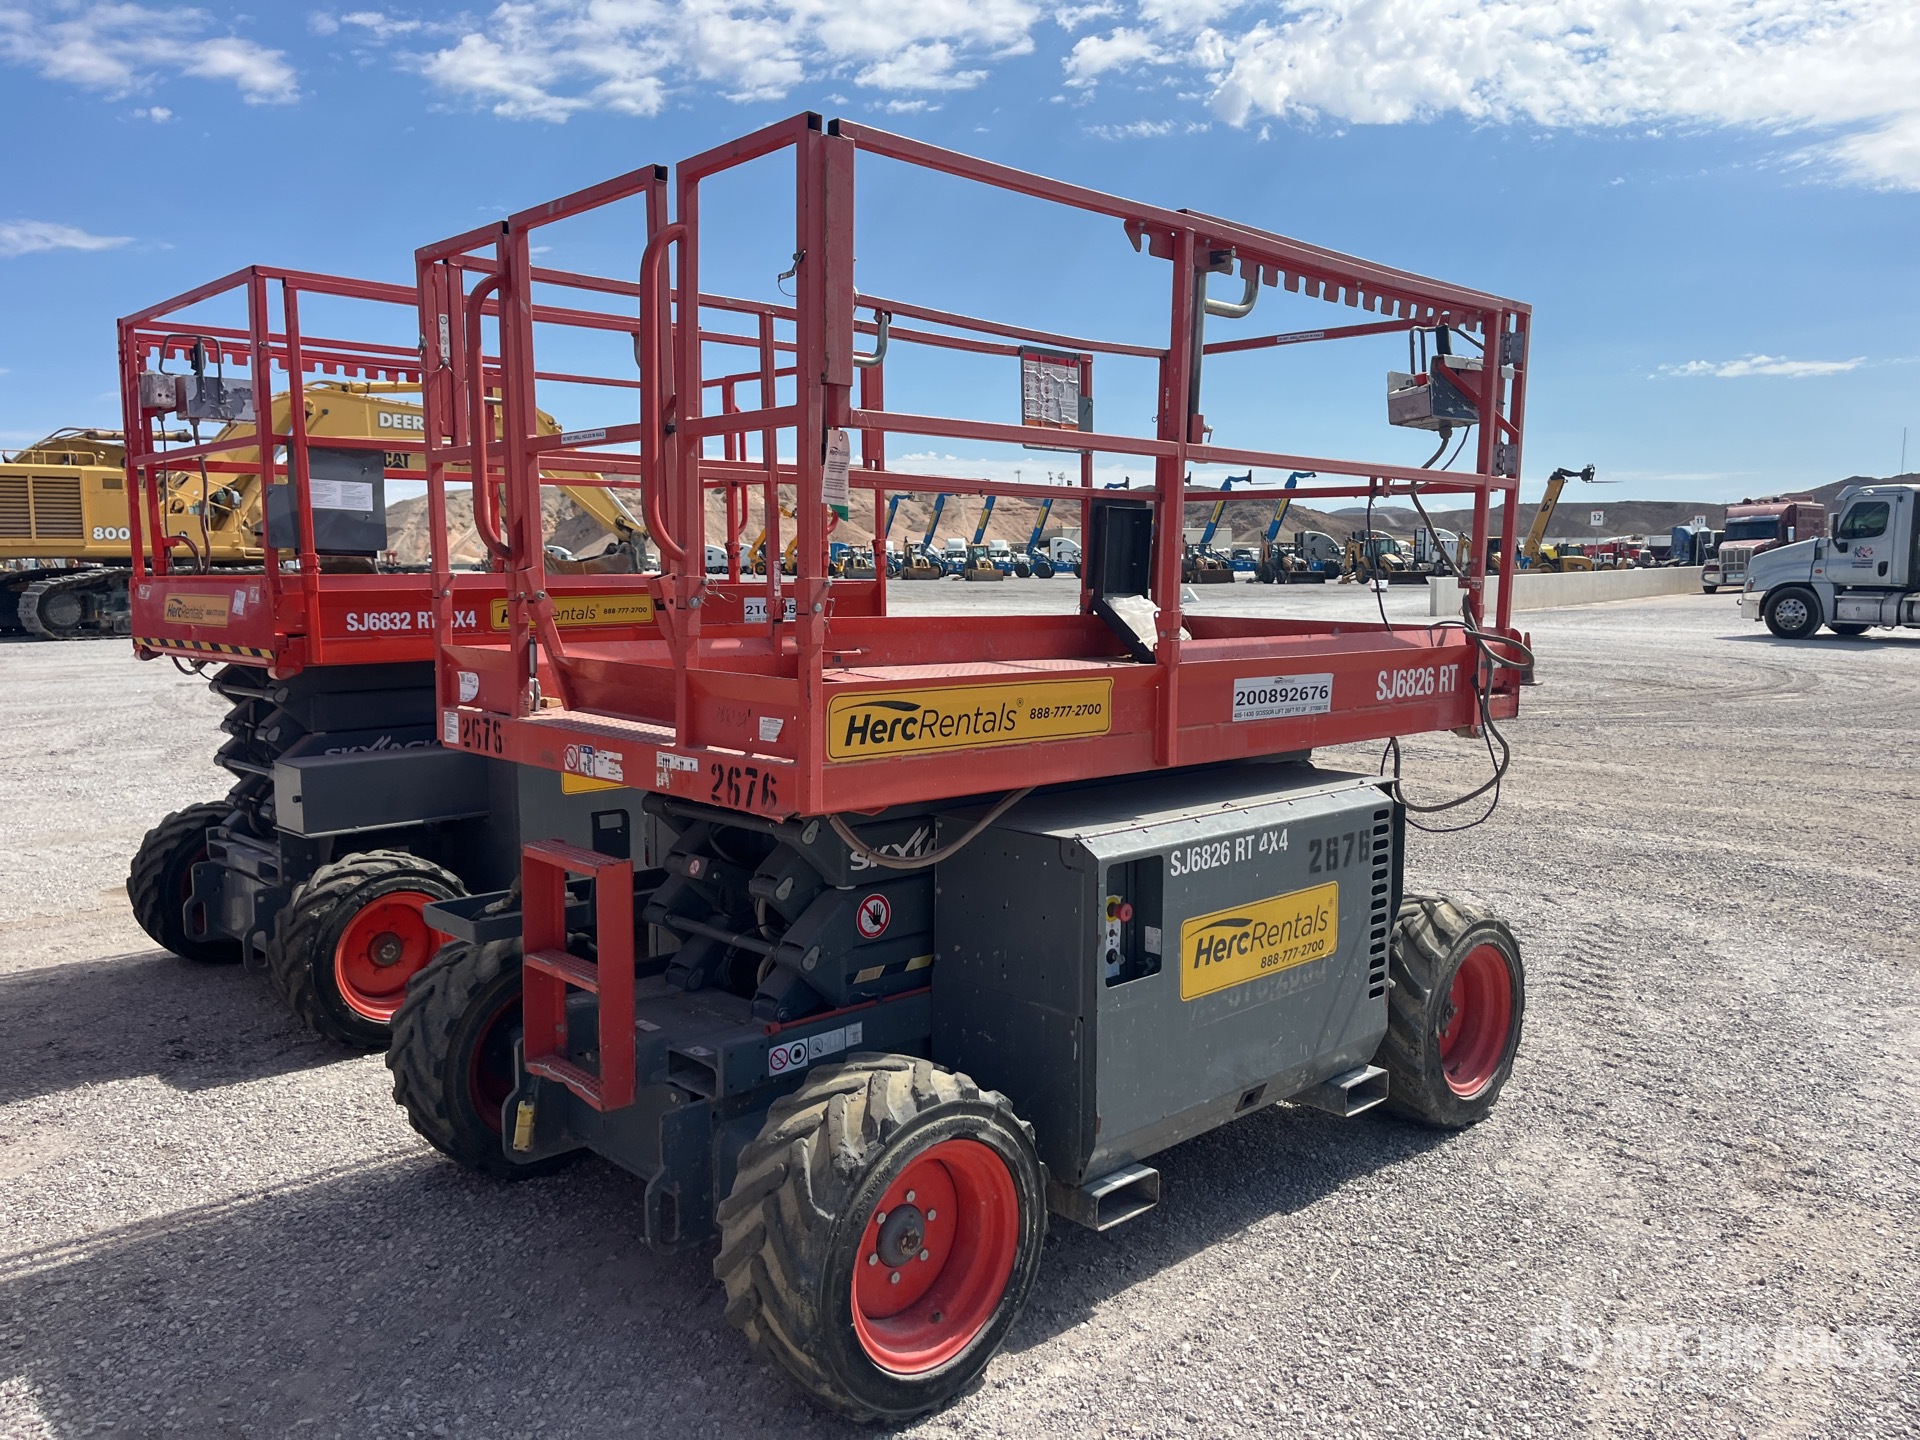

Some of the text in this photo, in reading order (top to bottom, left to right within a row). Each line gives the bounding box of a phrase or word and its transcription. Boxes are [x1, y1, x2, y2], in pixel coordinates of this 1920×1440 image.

[384, 452, 410, 468] CAT
[92, 526, 130, 540] 800
[346, 611, 411, 631] SJ6832
[451, 610, 476, 628] X4
[1235, 685, 1328, 706] 200892676
[1376, 664, 1458, 700] SJ6826 RT
[844, 702, 1102, 747] HercRentals 888-777-2700
[1255, 708, 1275, 717] SCISSOR
[463, 717, 502, 754] 2676
[711, 763, 777, 808] 2676
[1170, 828, 1288, 877] SJ6826 RT 4X4
[1309, 829, 1371, 874] 2676
[1193, 904, 1329, 969] HercRentals
[1260, 939, 1325, 969] 888-777-2700
